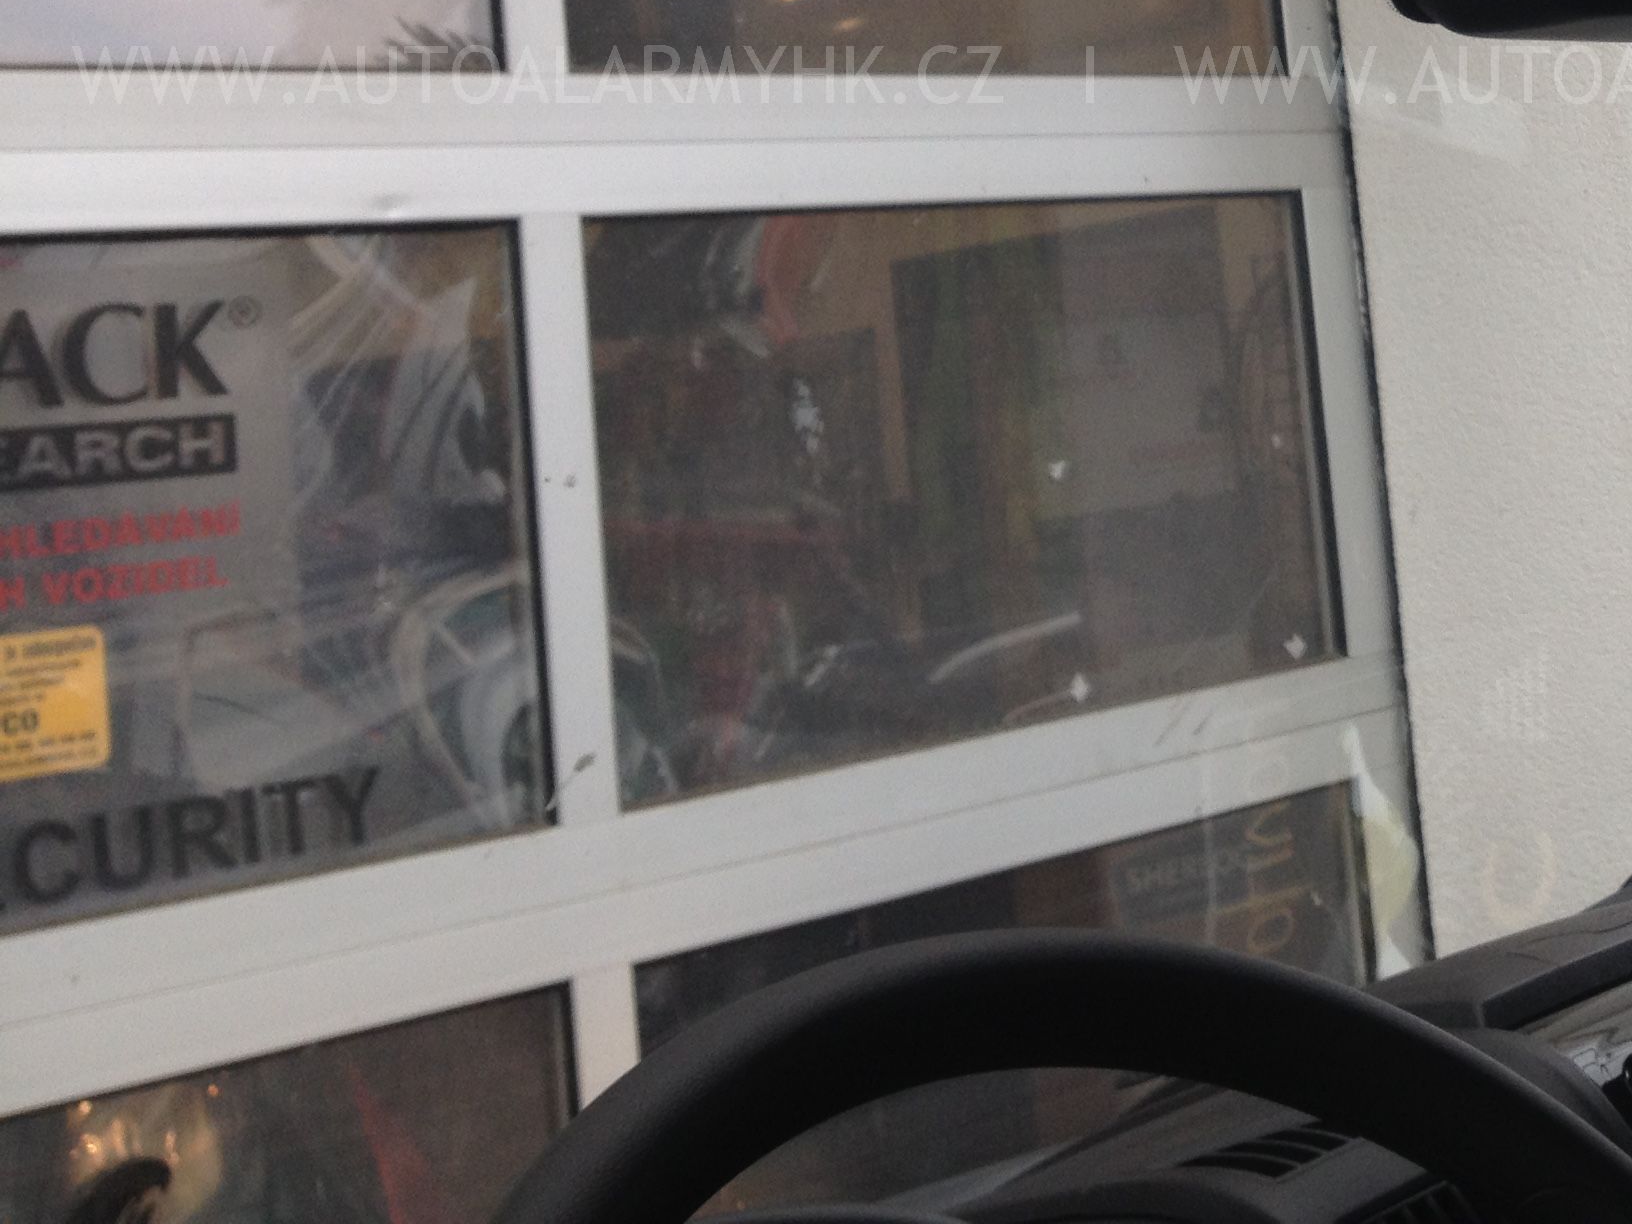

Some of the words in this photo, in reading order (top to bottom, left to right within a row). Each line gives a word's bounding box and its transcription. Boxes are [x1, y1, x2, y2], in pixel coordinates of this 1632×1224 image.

[0, 421, 226, 479] ARCH
[42, 554, 230, 605] VOZIDEL
[0, 765, 381, 912] CURITY
